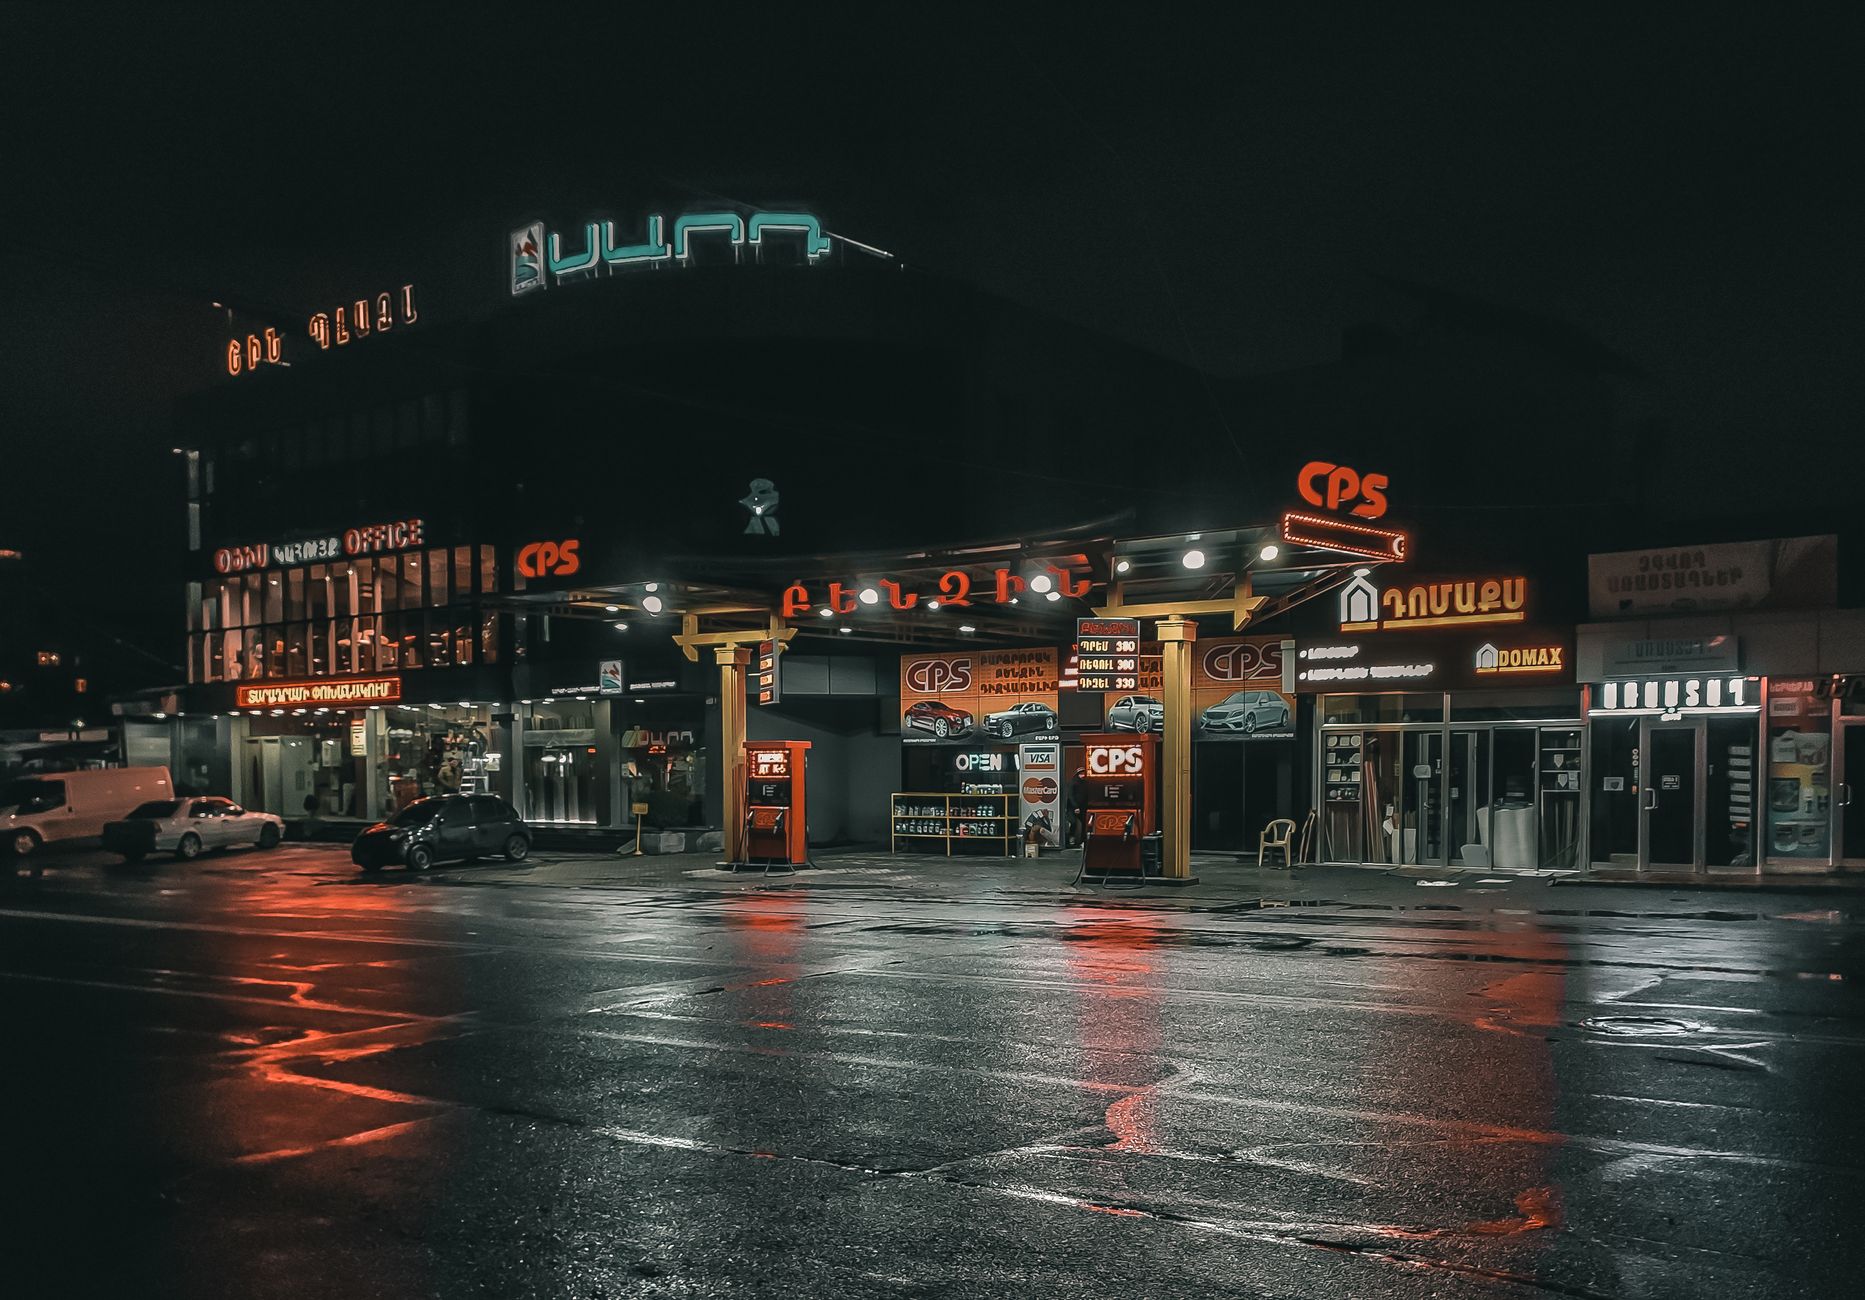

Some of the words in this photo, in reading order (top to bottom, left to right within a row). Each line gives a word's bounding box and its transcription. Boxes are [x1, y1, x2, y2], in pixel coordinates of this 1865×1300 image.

[1297, 461, 1389, 519] CPS
[343, 518, 425, 555] OFFICE
[516, 539, 581, 578] CPS
[1383, 576, 1526, 618] ԴՈՄԱՔՍ
[1203, 642, 1282, 681] CPS
[1498, 647, 1562, 667] DOMAX
[905, 658, 972, 693] CPS
[955, 753, 1002, 771] OPEN
[1030, 753, 1051, 763] VISA
[1090, 747, 1143, 773] CPS
